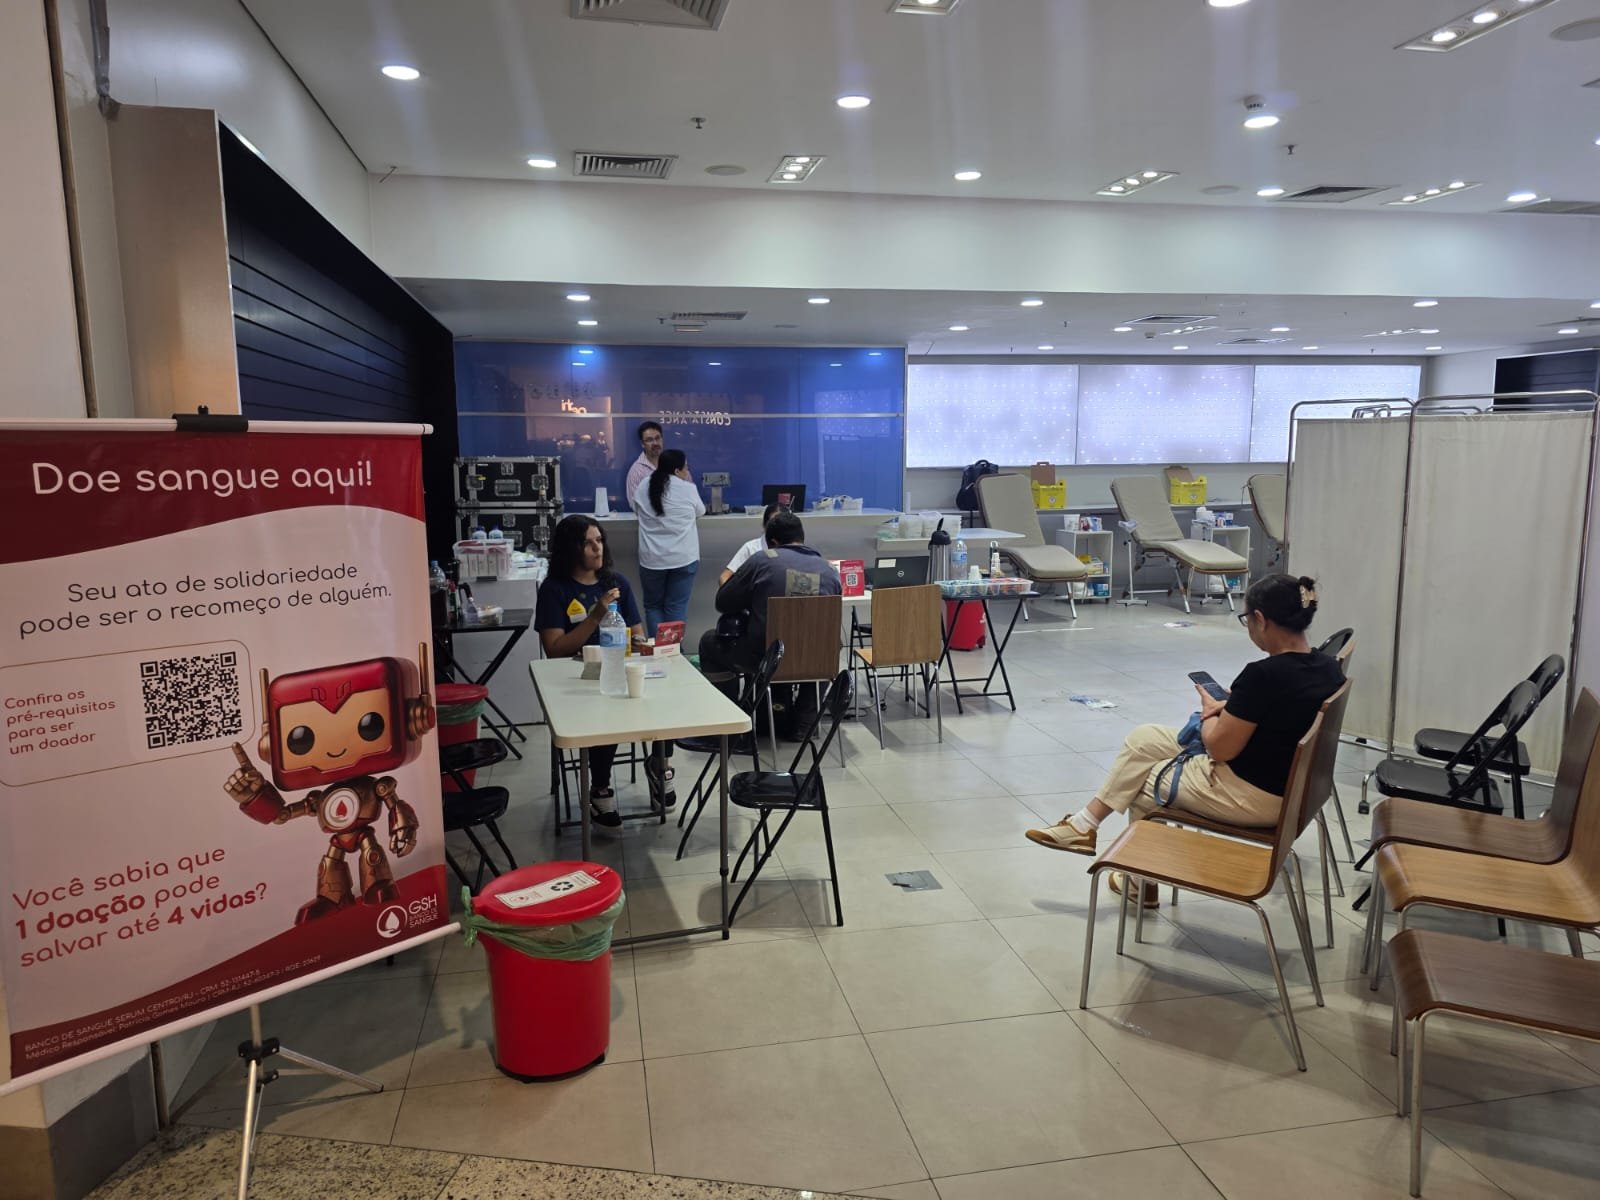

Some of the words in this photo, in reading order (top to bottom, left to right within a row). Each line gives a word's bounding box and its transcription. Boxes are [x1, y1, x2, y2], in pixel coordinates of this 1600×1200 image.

[32, 462, 120, 496] Doe
[136, 465, 280, 498] sangue
[291, 460, 373, 496] aqui!
[67, 582, 117, 603] Seu
[125, 579, 168, 598] ato
[175, 573, 206, 594] de
[213, 562, 358, 592] solidariedade
[19, 613, 90, 640] pode
[99, 609, 138, 627] ser
[147, 608, 162, 623] o
[171, 594, 281, 620] recomeço
[288, 588, 313, 608] de
[319, 582, 392, 608] alguém.
[4, 693, 63, 709] Confira
[67, 690, 85, 700] os
[6, 700, 116, 728] pré-requisitos
[8, 726, 46, 743] para
[50, 721, 74, 733] ser
[10, 743, 34, 755] um
[39, 733, 96, 750] doador
[12, 877, 84, 910] Você
[93, 861, 169, 891] sabia
[177, 848, 225, 874] que
[15, 919, 28, 940] 1
[36, 895, 146, 935] doação
[154, 875, 220, 908] pode
[408, 893, 437, 914] GSH
[409, 913, 438, 928] SANGUE
[20, 930, 108, 967] salvar
[117, 912, 160, 940] até
[167, 906, 184, 925] 4
[190, 882, 267, 919] vidas?
[25, 1034, 59, 1052] BANCO
[61, 1031, 74, 1041] DE
[76, 1018, 113, 1036] SANGUE
[115, 1008, 145, 1023] SERUM
